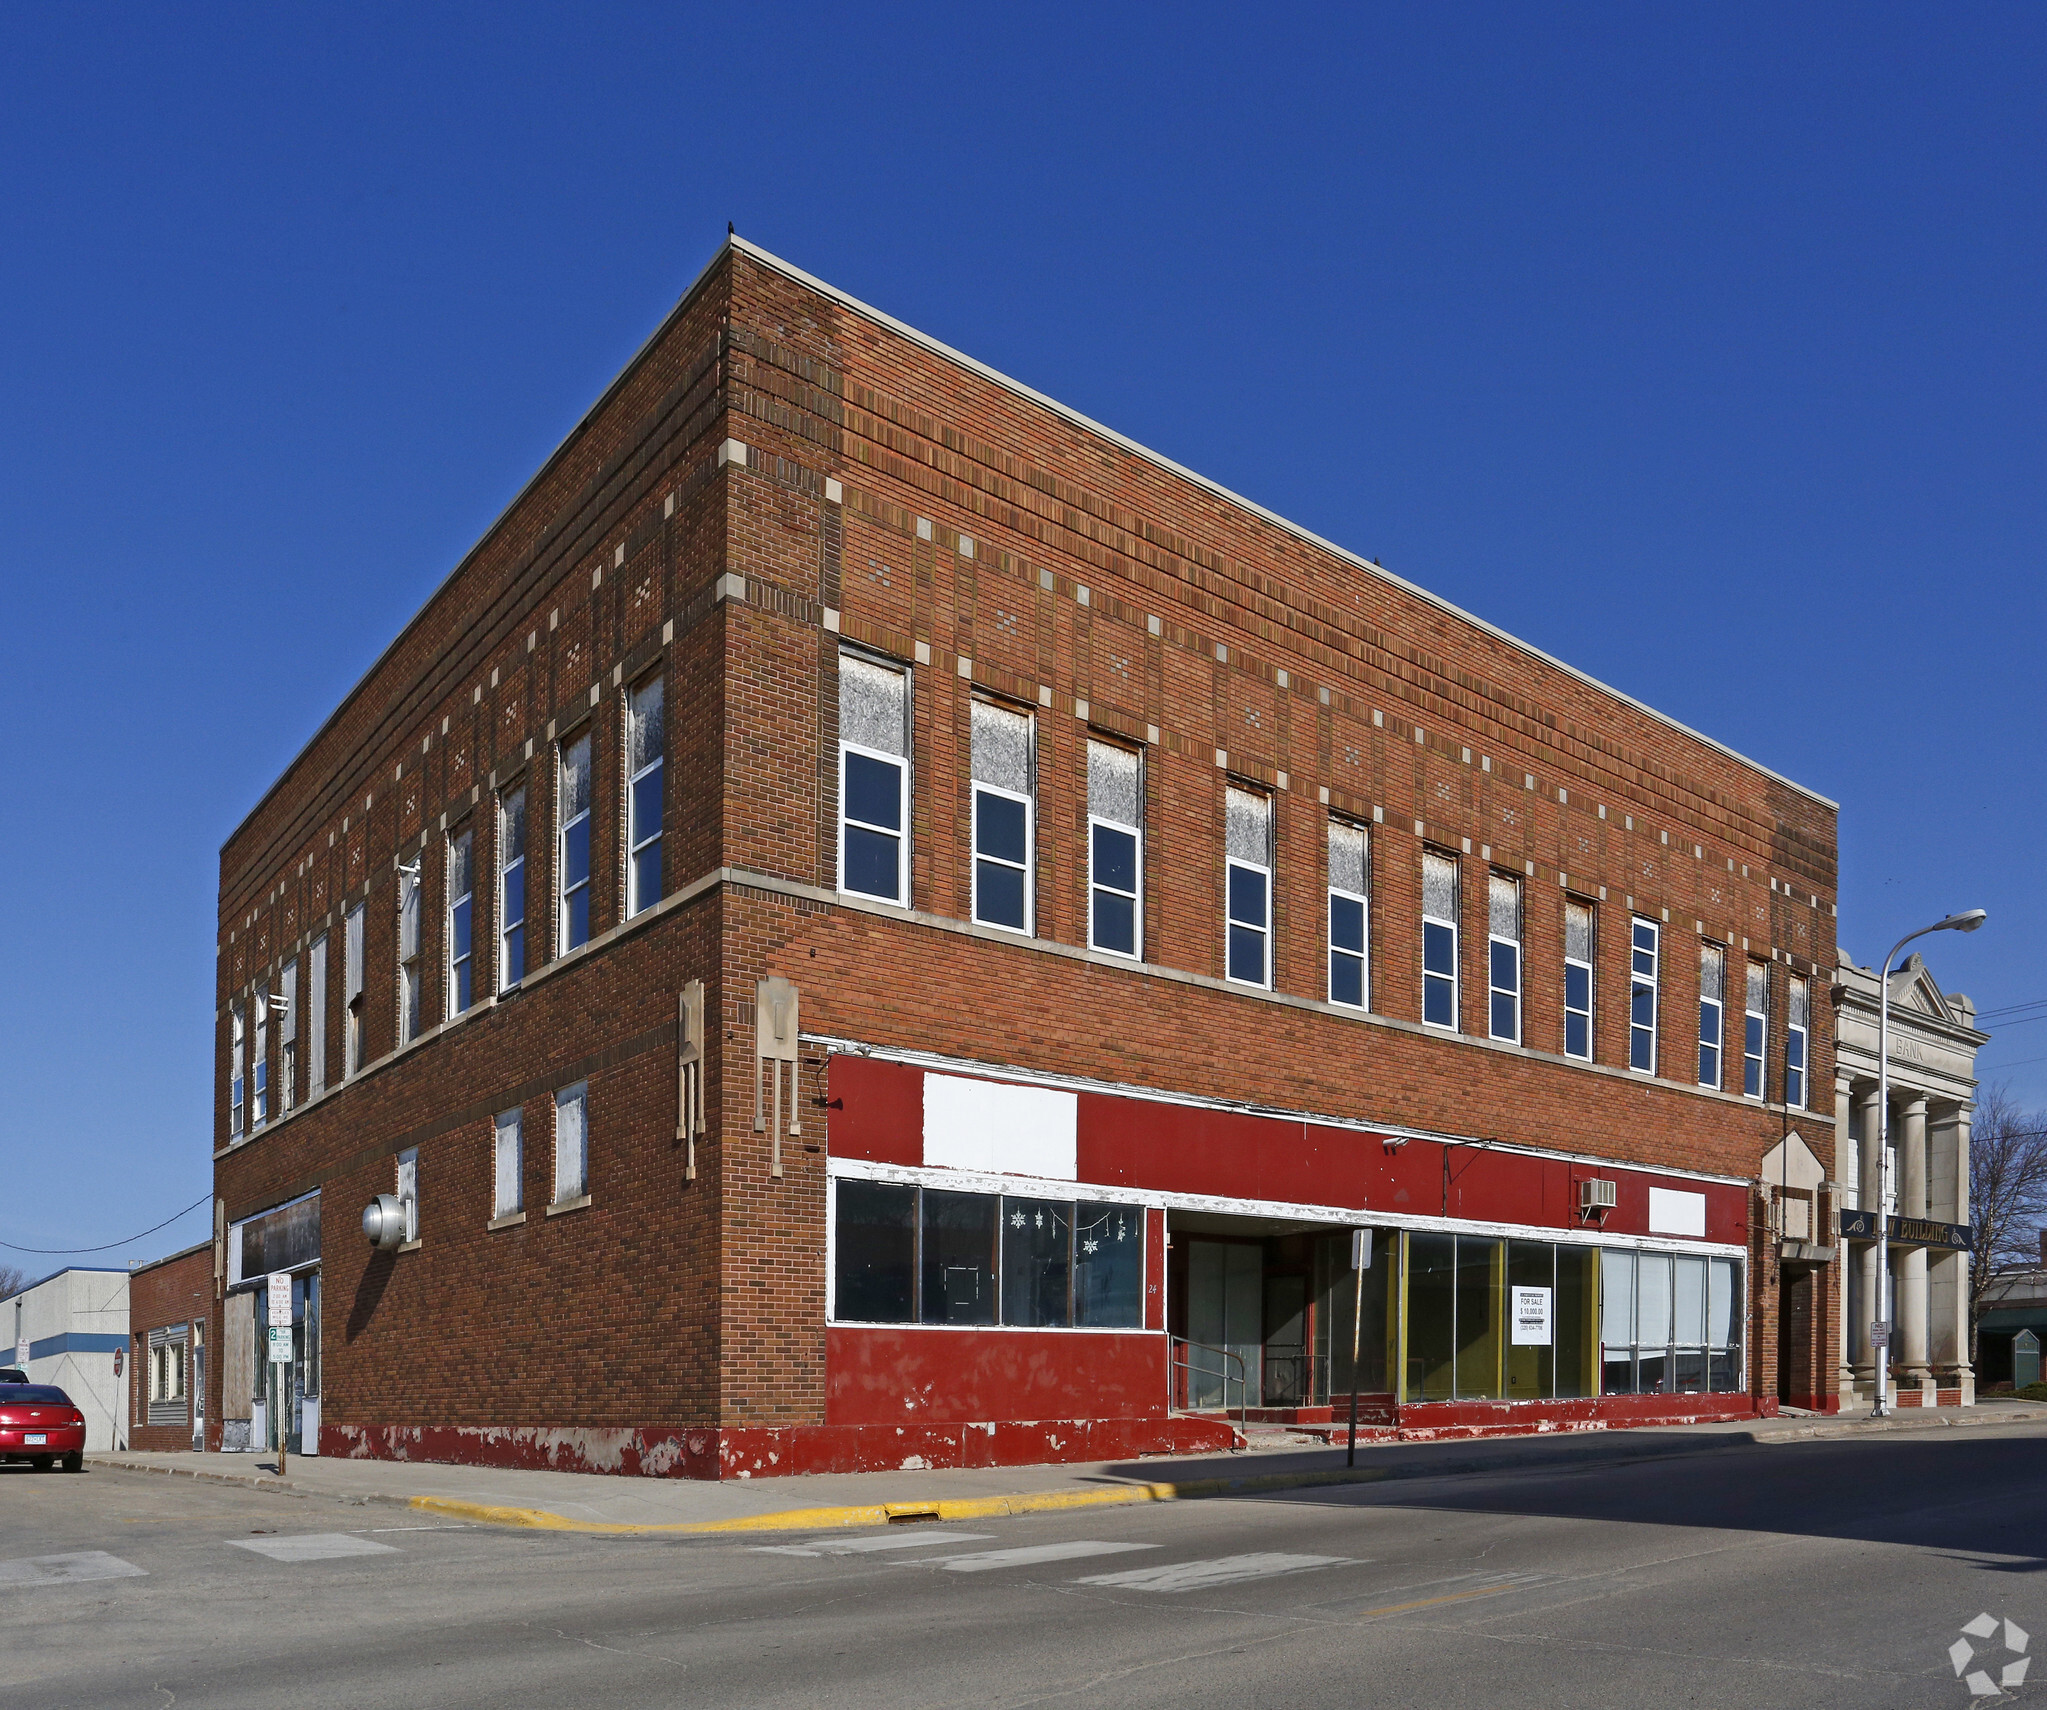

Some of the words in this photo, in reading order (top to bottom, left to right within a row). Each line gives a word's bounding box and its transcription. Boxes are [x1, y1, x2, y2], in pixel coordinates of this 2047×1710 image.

[1896, 1037, 1923, 1061] BANK
[1872, 1216, 1896, 1237] LW
[1900, 1219, 1948, 1243] BUILDING
[1148, 1284, 1157, 1294] 24
[270, 1330, 276, 1339] 2
